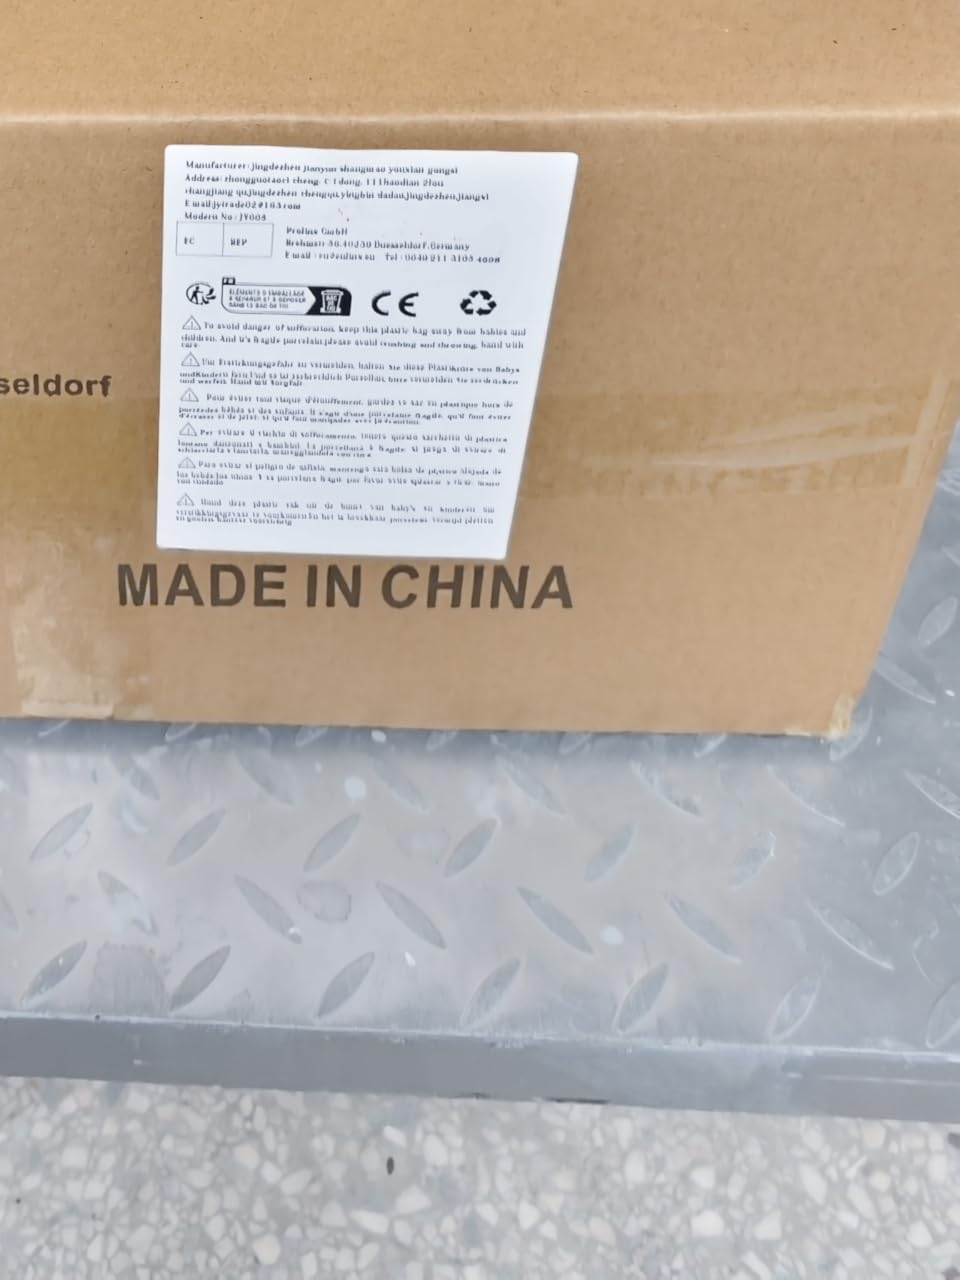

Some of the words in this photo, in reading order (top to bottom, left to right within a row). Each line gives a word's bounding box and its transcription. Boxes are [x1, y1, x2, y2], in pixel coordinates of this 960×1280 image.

[117, 563, 287, 607] MADE
[306, 564, 362, 609] IN
[381, 564, 574, 610] CHINA
